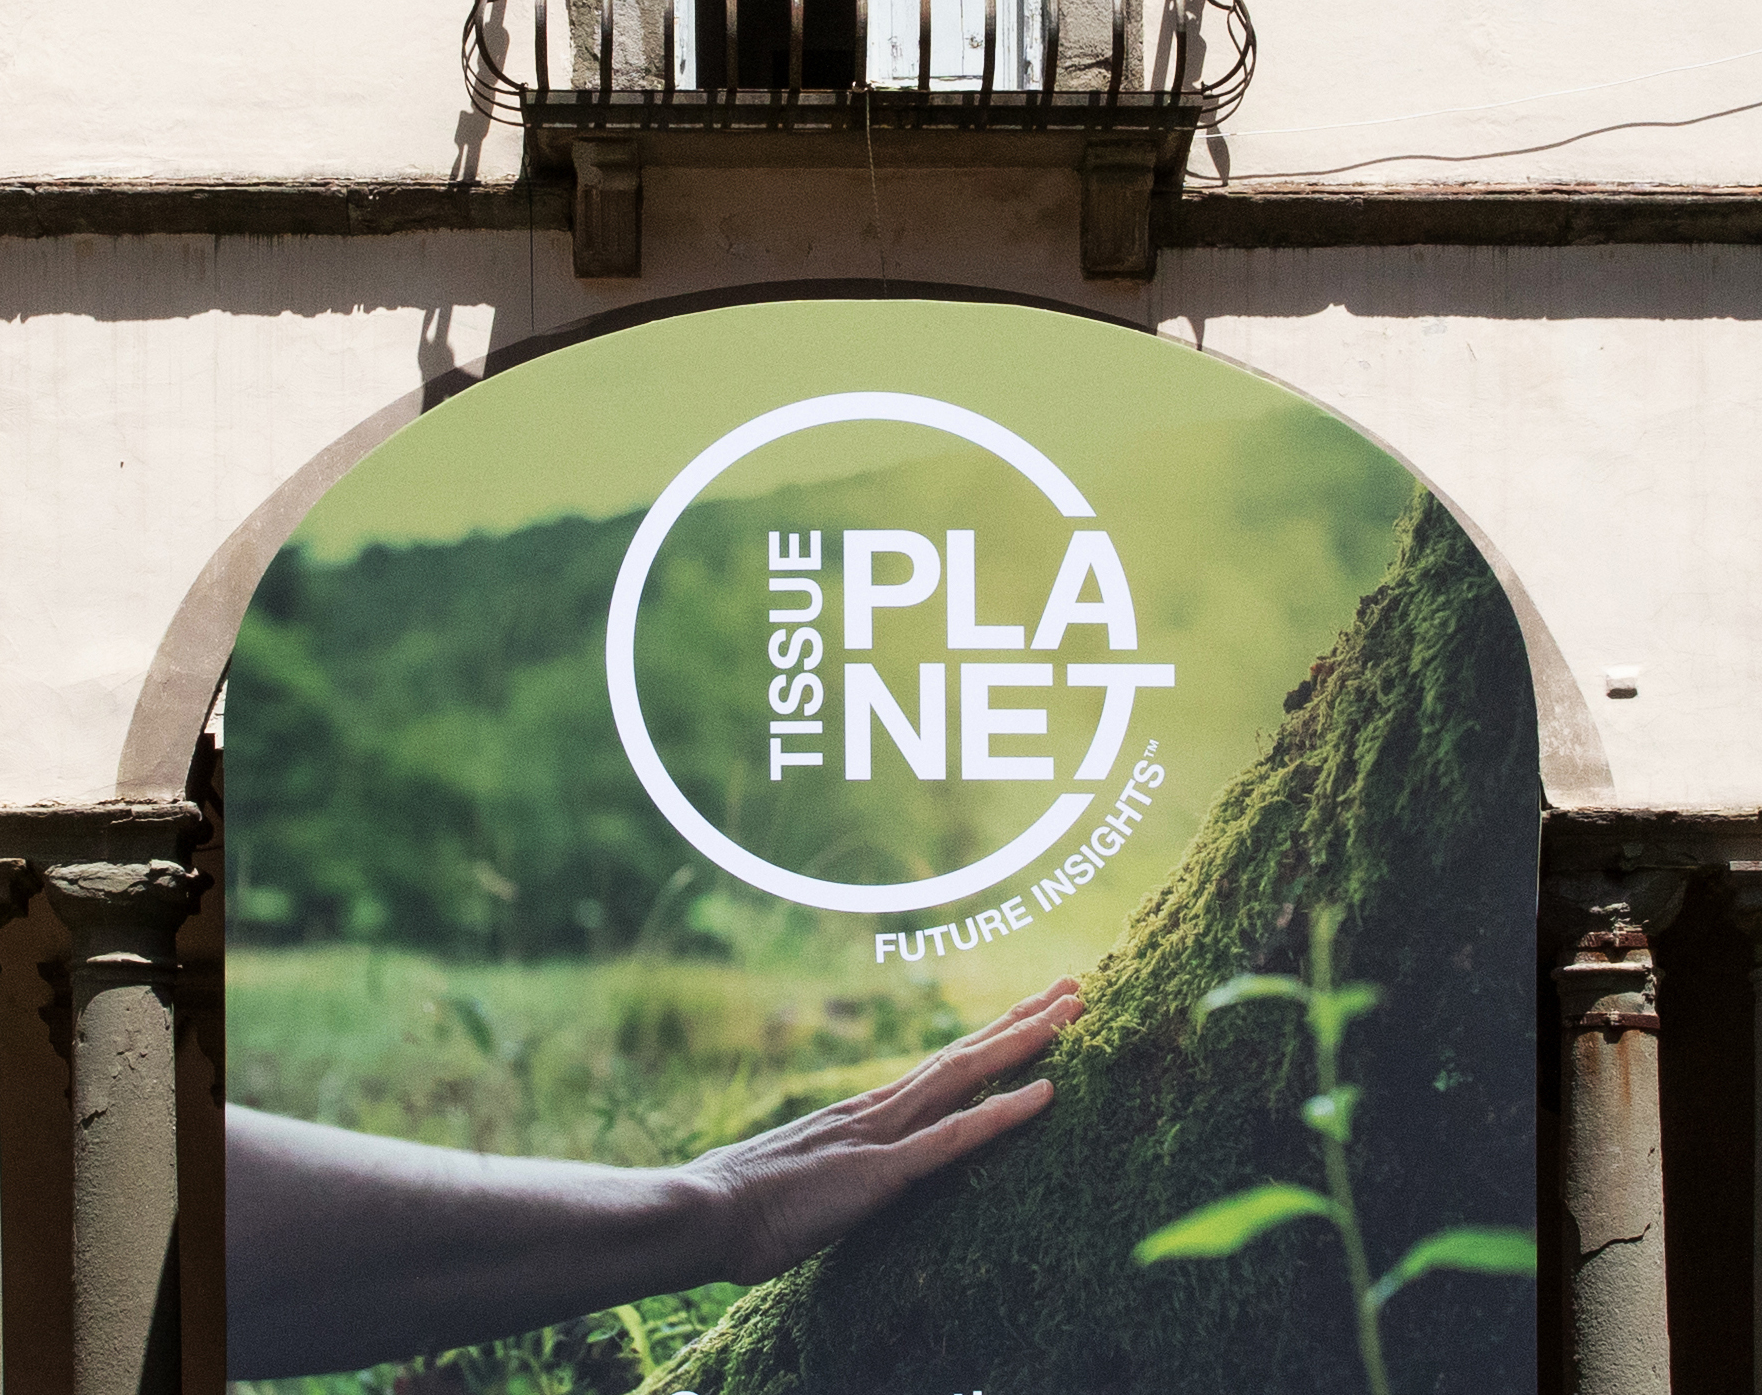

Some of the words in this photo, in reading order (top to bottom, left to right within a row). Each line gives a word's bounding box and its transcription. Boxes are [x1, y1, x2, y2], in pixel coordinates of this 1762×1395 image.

[843, 529, 1138, 650] PLA
[768, 529, 824, 781] TISSUE
[843, 662, 1175, 781] NET
[875, 895, 1033, 963] FUTURE
